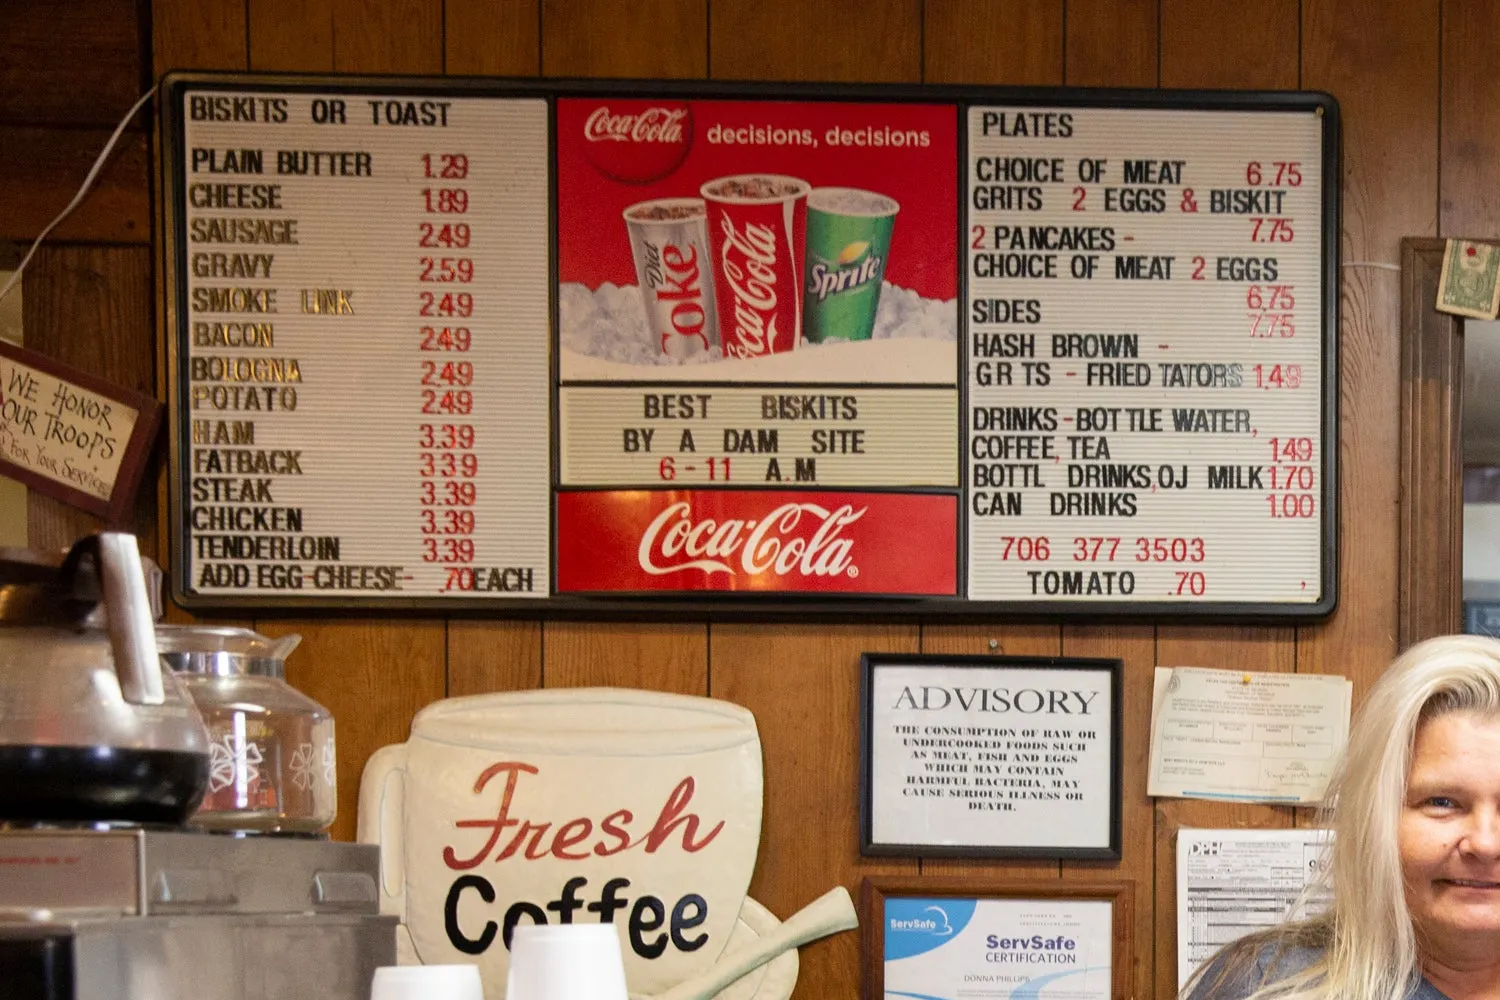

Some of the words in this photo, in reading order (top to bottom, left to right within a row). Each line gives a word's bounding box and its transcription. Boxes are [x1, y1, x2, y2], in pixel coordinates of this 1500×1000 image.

[190, 97, 288, 122] BISKITS
[312, 100, 346, 124] OR
[368, 101, 450, 126] TOAST
[707, 124, 818, 148] decisions,
[826, 125, 930, 147] decisions
[983, 112, 1072, 137] PLATES
[192, 149, 262, 173] PLAIN
[277, 151, 371, 176] BUTTER
[422, 154, 469, 179] 1.29
[977, 158, 1064, 182] CHOICE
[1078, 159, 1107, 183] OF
[1124, 161, 1186, 184] MEAT
[1246, 162, 1302, 186] 6.75
[189, 184, 282, 209] CHEESE
[973, 186, 1042, 210] GRITS
[1072, 187, 1086, 211] 2
[1104, 188, 1166, 212] EGGS
[1181, 188, 1197, 212] &
[1210, 190, 1286, 214] BISKIT
[190, 218, 298, 244] SAUSAGE
[419, 223, 470, 248] 2.49
[972, 225, 986, 249] 2
[1250, 219, 1294, 242] 7.75
[192, 253, 274, 278] GRAVY
[420, 258, 474, 283] 2.59
[647, 240, 664, 289] Diet
[973, 254, 1057, 278] CHOICE
[1071, 255, 1098, 279] OF
[1115, 256, 1175, 280] MEAT
[1192, 257, 1205, 280] 2
[1217, 257, 1278, 281] EGGS
[808, 255, 880, 300] Sprite
[192, 288, 276, 313] SMOKE
[419, 292, 473, 317] 2.49
[1246, 286, 1295, 311] 6.75
[973, 299, 1041, 324] SIDES
[193, 322, 274, 348] BACON
[419, 326, 471, 352] 2.49
[1250, 315, 1295, 337] 7.75
[973, 334, 1034, 357] HASH
[1052, 335, 1138, 357] BROWN
[191, 357, 302, 383] BOLOGNA
[422, 361, 474, 387] 2.49
[1087, 363, 1150, 387] FRIED
[1159, 363, 1243, 387] TATORS
[8, 368, 39, 402] WE
[52, 384, 112, 431] HONOR
[193, 386, 297, 411] POTATO
[422, 391, 473, 415] 2.49
[644, 394, 712, 420] BEST
[762, 395, 858, 421] BISKITS
[2, 398, 37, 436] OUR
[44, 411, 116, 459] TROOPS
[193, 421, 254, 445] HAM
[419, 424, 475, 449] 3.39
[1172, 409, 1258, 438] WATER,
[623, 429, 654, 453] BY
[680, 430, 695, 453] A
[723, 429, 778, 453] DAM
[811, 430, 865, 454] SITE
[972, 436, 1060, 463] COFFEE,
[1067, 437, 1110, 460] TEA
[1268, 438, 1313, 463] 1.49
[193, 450, 303, 475] FATBACK
[1208, 465, 1263, 489] MILK
[1266, 466, 1313, 489] 1.70
[193, 478, 273, 502] STEAK
[421, 481, 475, 506] 3.39
[973, 492, 1022, 516] CAN
[1051, 493, 1136, 516] DRINKS
[1266, 494, 1313, 518] 1.00
[192, 507, 302, 532] CHICKEN
[421, 510, 475, 535] 3.39
[198, 536, 340, 561] TENDERLOIN
[422, 538, 474, 563] 3.39
[1001, 537, 1050, 560] 706
[1073, 538, 1120, 561] 377
[1136, 538, 1205, 562] 3503
[201, 564, 249, 588] ADD
[1027, 571, 1135, 594] TOMATO
[1168, 572, 1205, 595] .70
[892, 686, 1099, 715] ADVISORY
[894, 725, 919, 735] THE
[925, 726, 1016, 736] CONSUMPTION
[1022, 728, 1039, 737] OF
[1044, 729, 1073, 738] RAW
[1079, 730, 1096, 739] OR
[904, 738, 1001, 749] UNDERCOOKED
[1007, 740, 1048, 750] FOODS
[1053, 742, 1086, 751] SUCH
[911, 751, 927, 759] AS
[978, 752, 1007, 761] FISH
[1013, 753, 1039, 762] AND
[1045, 754, 1078, 763] EGGS
[925, 764, 967, 773] WHICH
[973, 764, 1002, 773] MAY
[1008, 766, 1064, 775] CONTAIN
[903, 788, 944, 797] CAUSE
[949, 789, 1003, 798] SERIOUS
[1009, 790, 1060, 800] ILLNESS
[1066, 791, 1083, 800] OR
[907, 776, 970, 785] HARMFUL
[1052, 779, 1080, 788] MAY
[443, 761, 725, 870] Fresh
[891, 919, 936, 929] ServSafe
[986, 935, 1075, 950] ServSafe
[986, 952, 1076, 964] CERTIFICATION
